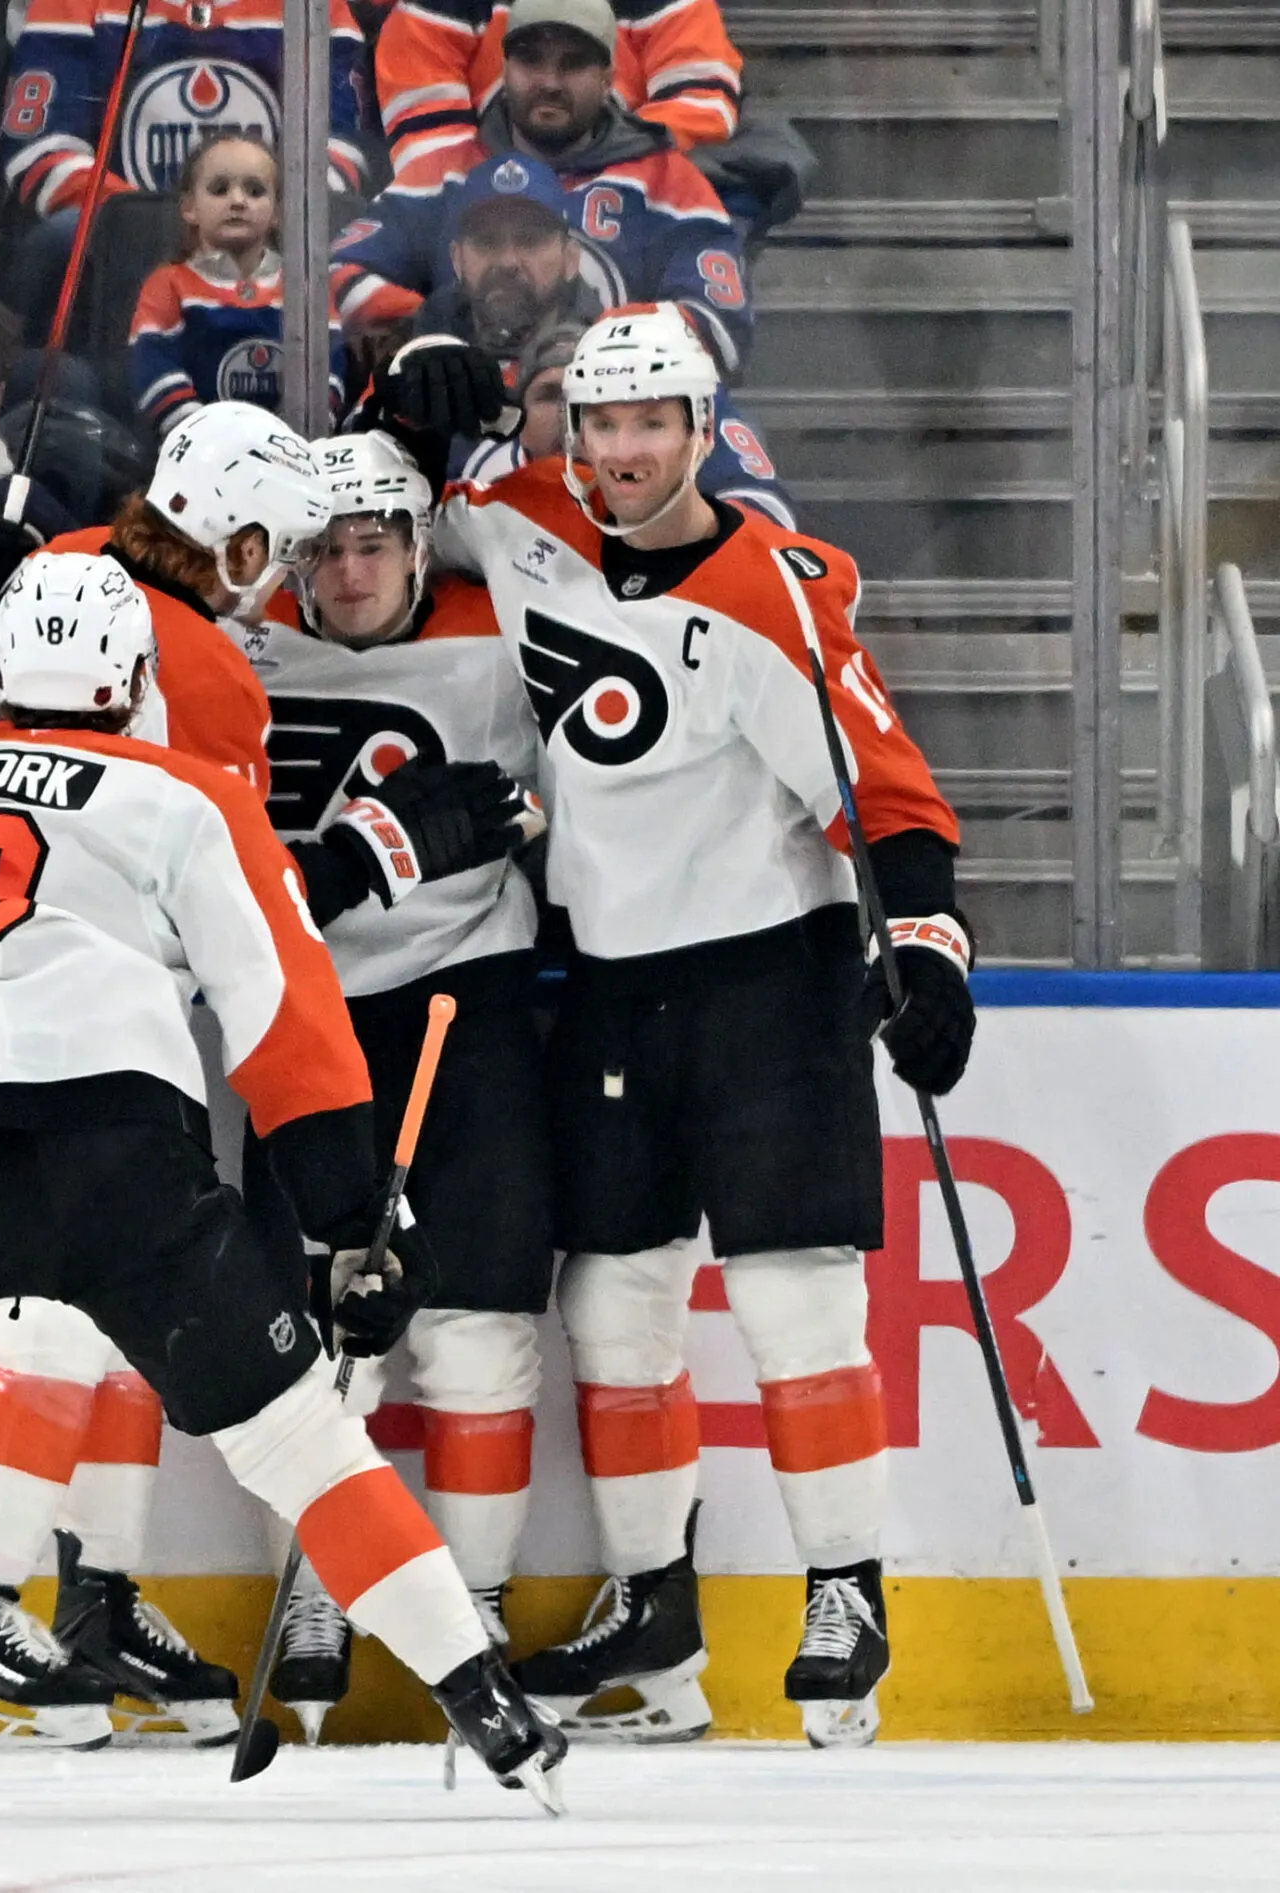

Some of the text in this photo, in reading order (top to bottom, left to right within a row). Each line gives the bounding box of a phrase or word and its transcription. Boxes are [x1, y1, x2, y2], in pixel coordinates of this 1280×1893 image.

[582, 187, 623, 241] C
[697, 249, 745, 309] 9
[607, 325, 632, 339] 14
[594, 366, 635, 376] CCM
[323, 448, 354, 467] 52
[720, 418, 775, 480] 9
[331, 479, 362, 493] CM
[47, 616, 64, 645] 8
[682, 616, 710, 670] C
